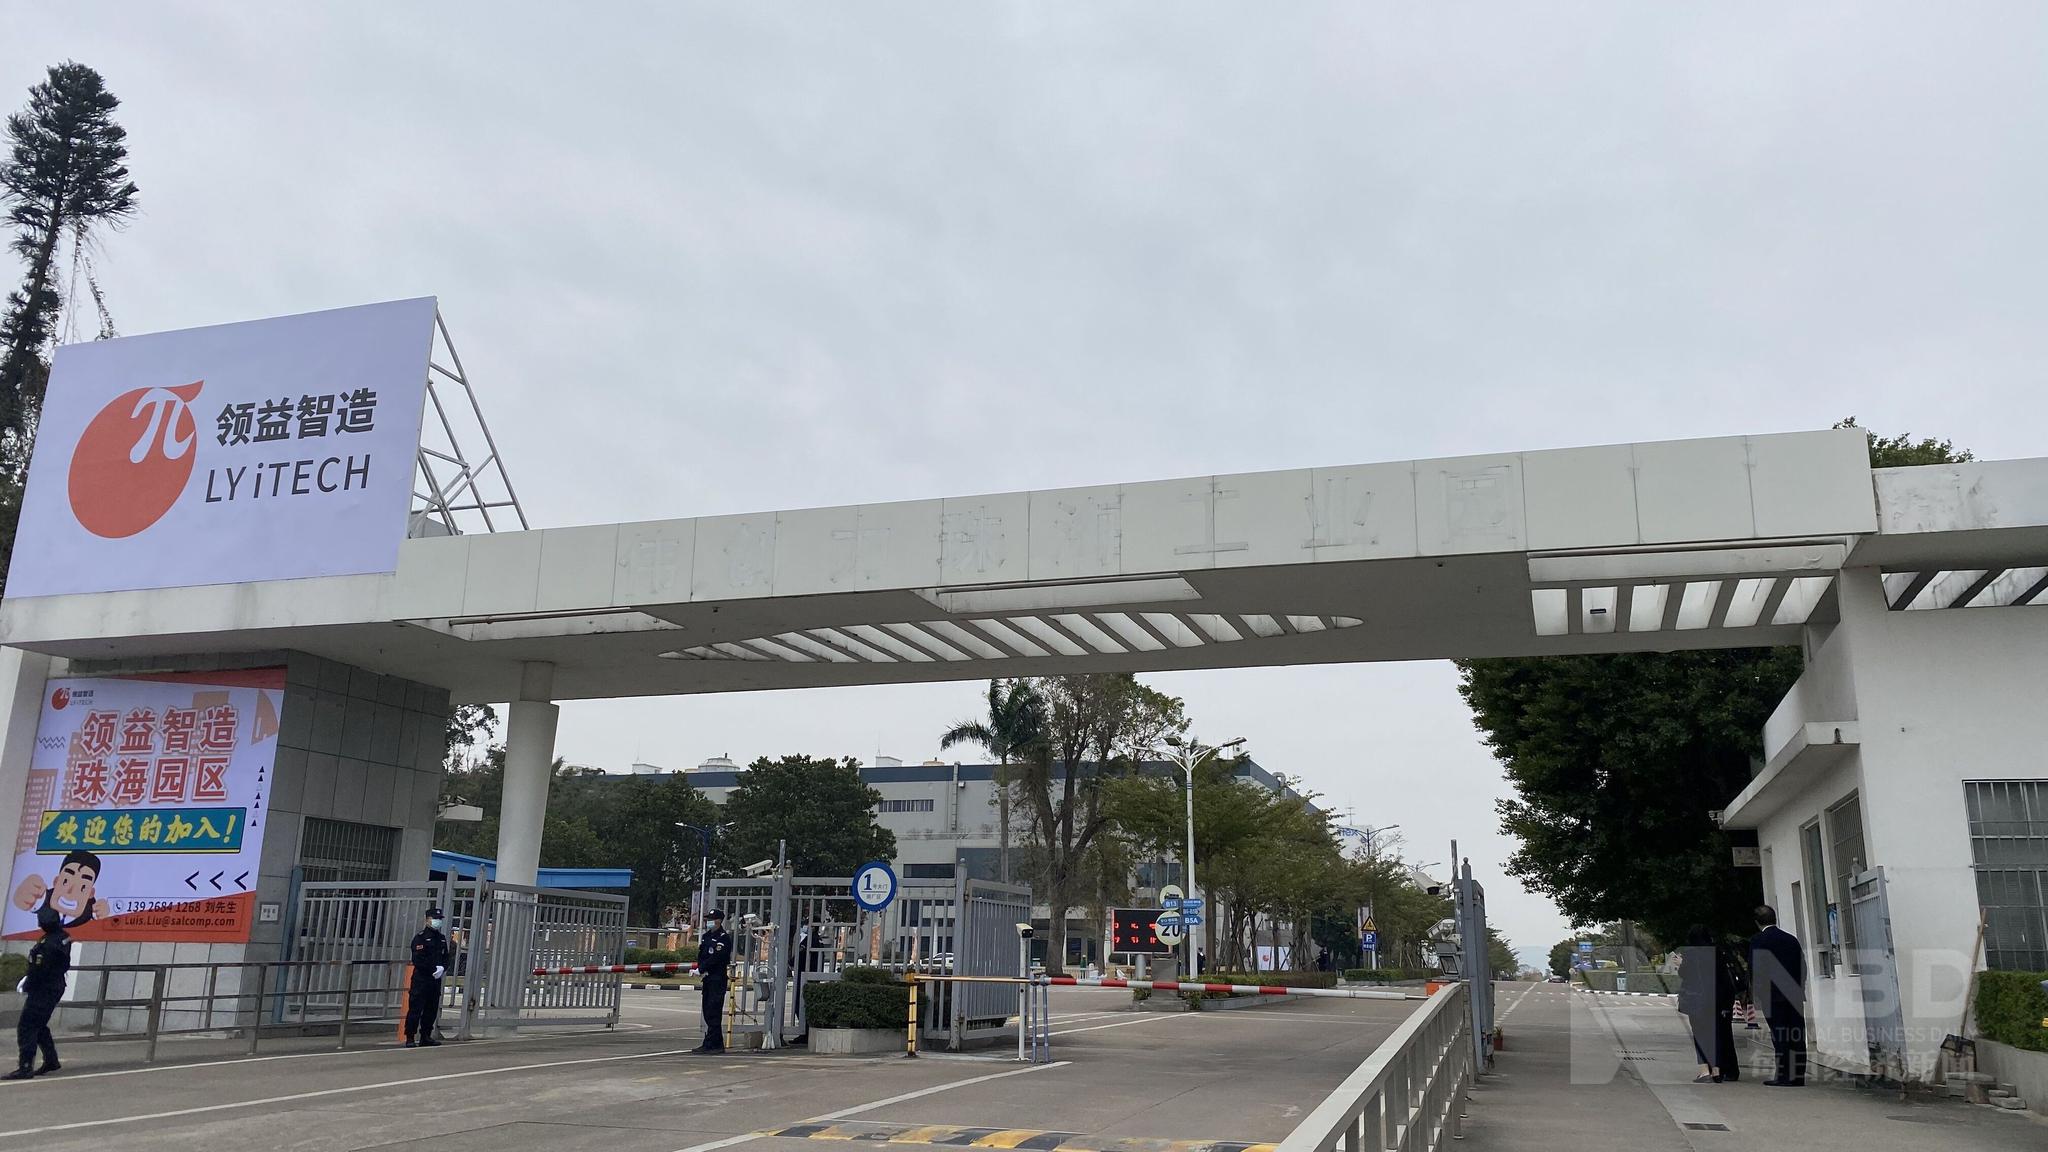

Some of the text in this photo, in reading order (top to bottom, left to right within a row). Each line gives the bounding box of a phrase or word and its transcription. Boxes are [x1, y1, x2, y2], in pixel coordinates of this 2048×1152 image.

[216, 388, 377, 446] 领益智造
[82, 706, 237, 754] 领益智造
[72, 756, 229, 802] 珠海园区
[127, 901, 237, 914] 139 2684 1268 刘先生
[125, 915, 235, 928] Luis.Liu@salcomp.com
[1161, 925, 1180, 937] 20
[1366, 934, 1373, 943] P
